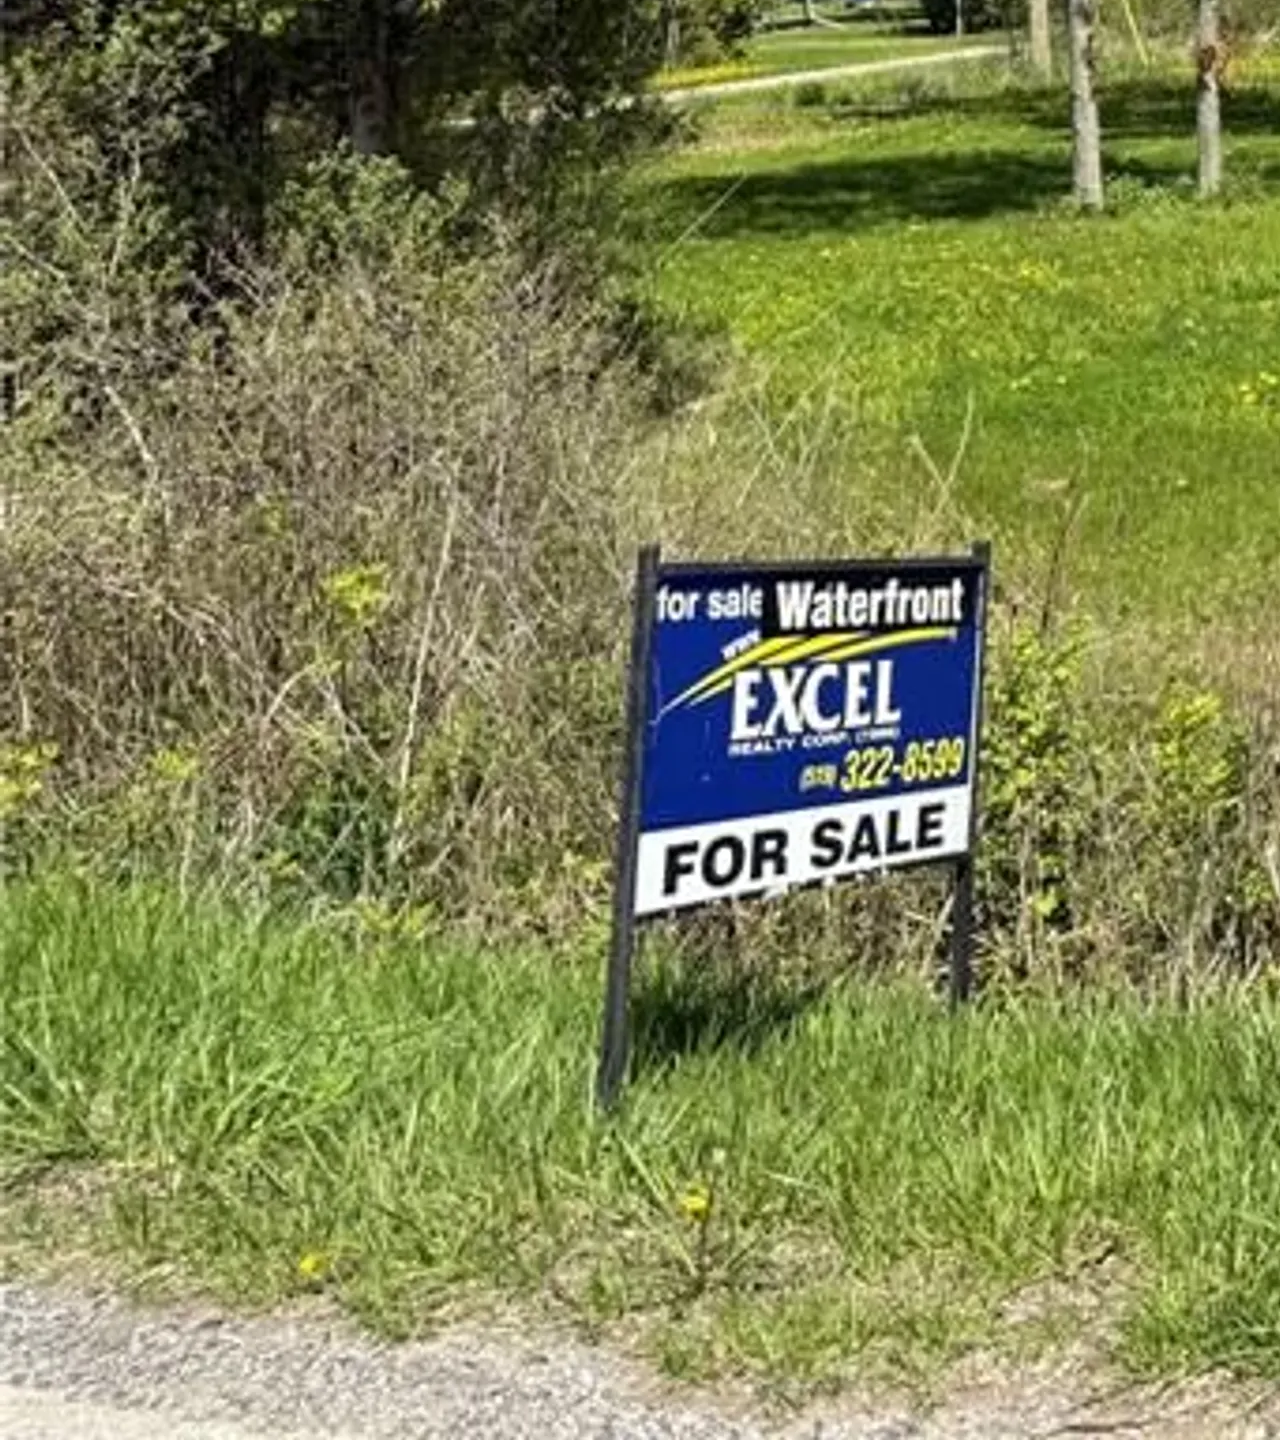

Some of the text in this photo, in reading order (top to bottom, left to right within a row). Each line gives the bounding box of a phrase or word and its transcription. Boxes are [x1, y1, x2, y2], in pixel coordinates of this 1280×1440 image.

[657, 584, 699, 621] for
[776, 577, 963, 630] Waterfront
[731, 660, 901, 739] EXCEL
[727, 737, 796, 757] REALTY
[840, 736, 965, 792] 322-8599
[663, 802, 946, 897] FOR SALE
